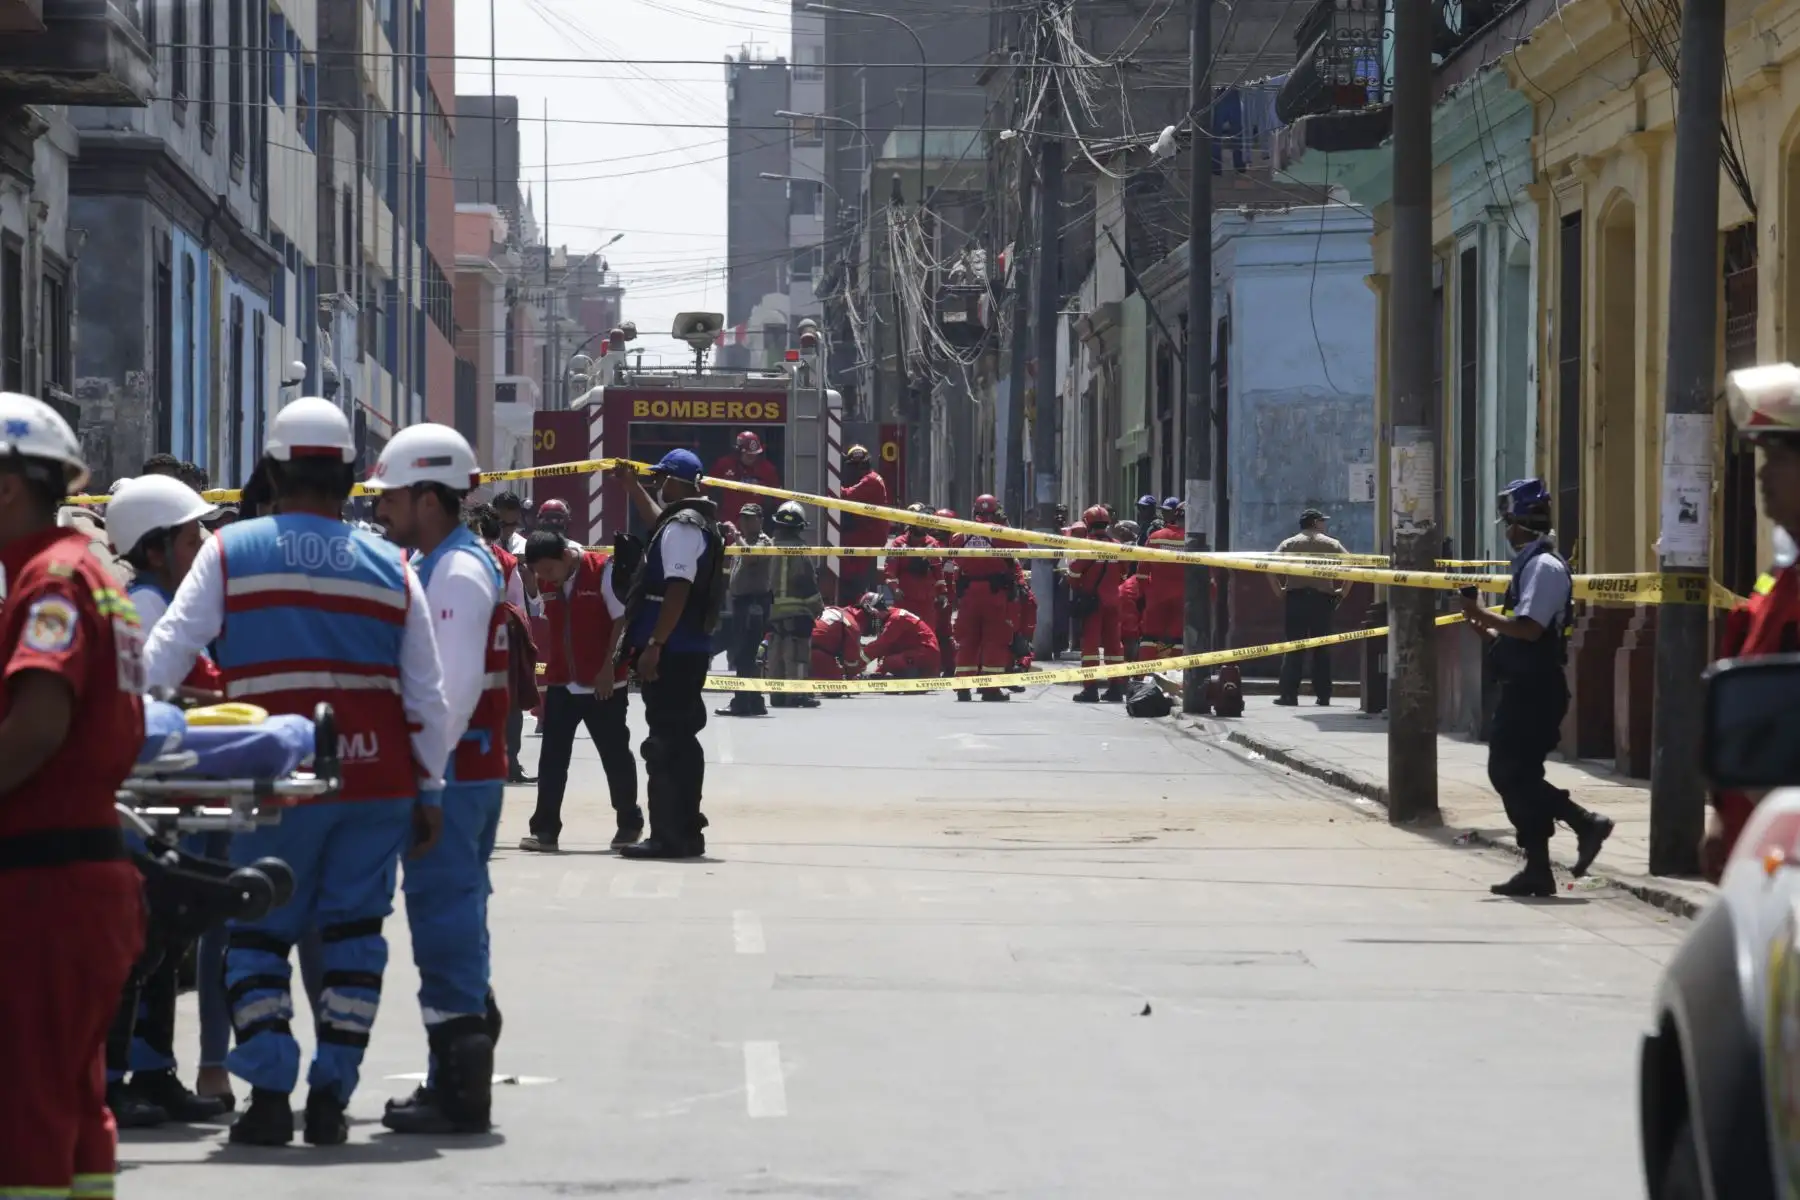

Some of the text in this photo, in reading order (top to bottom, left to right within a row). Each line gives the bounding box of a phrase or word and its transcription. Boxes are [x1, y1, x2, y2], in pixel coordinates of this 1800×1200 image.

[633, 400, 780, 420] BOMBEROS
[277, 530, 356, 571] 106
[1588, 578, 1638, 592] PELIGRO
[336, 732, 379, 760] MU
